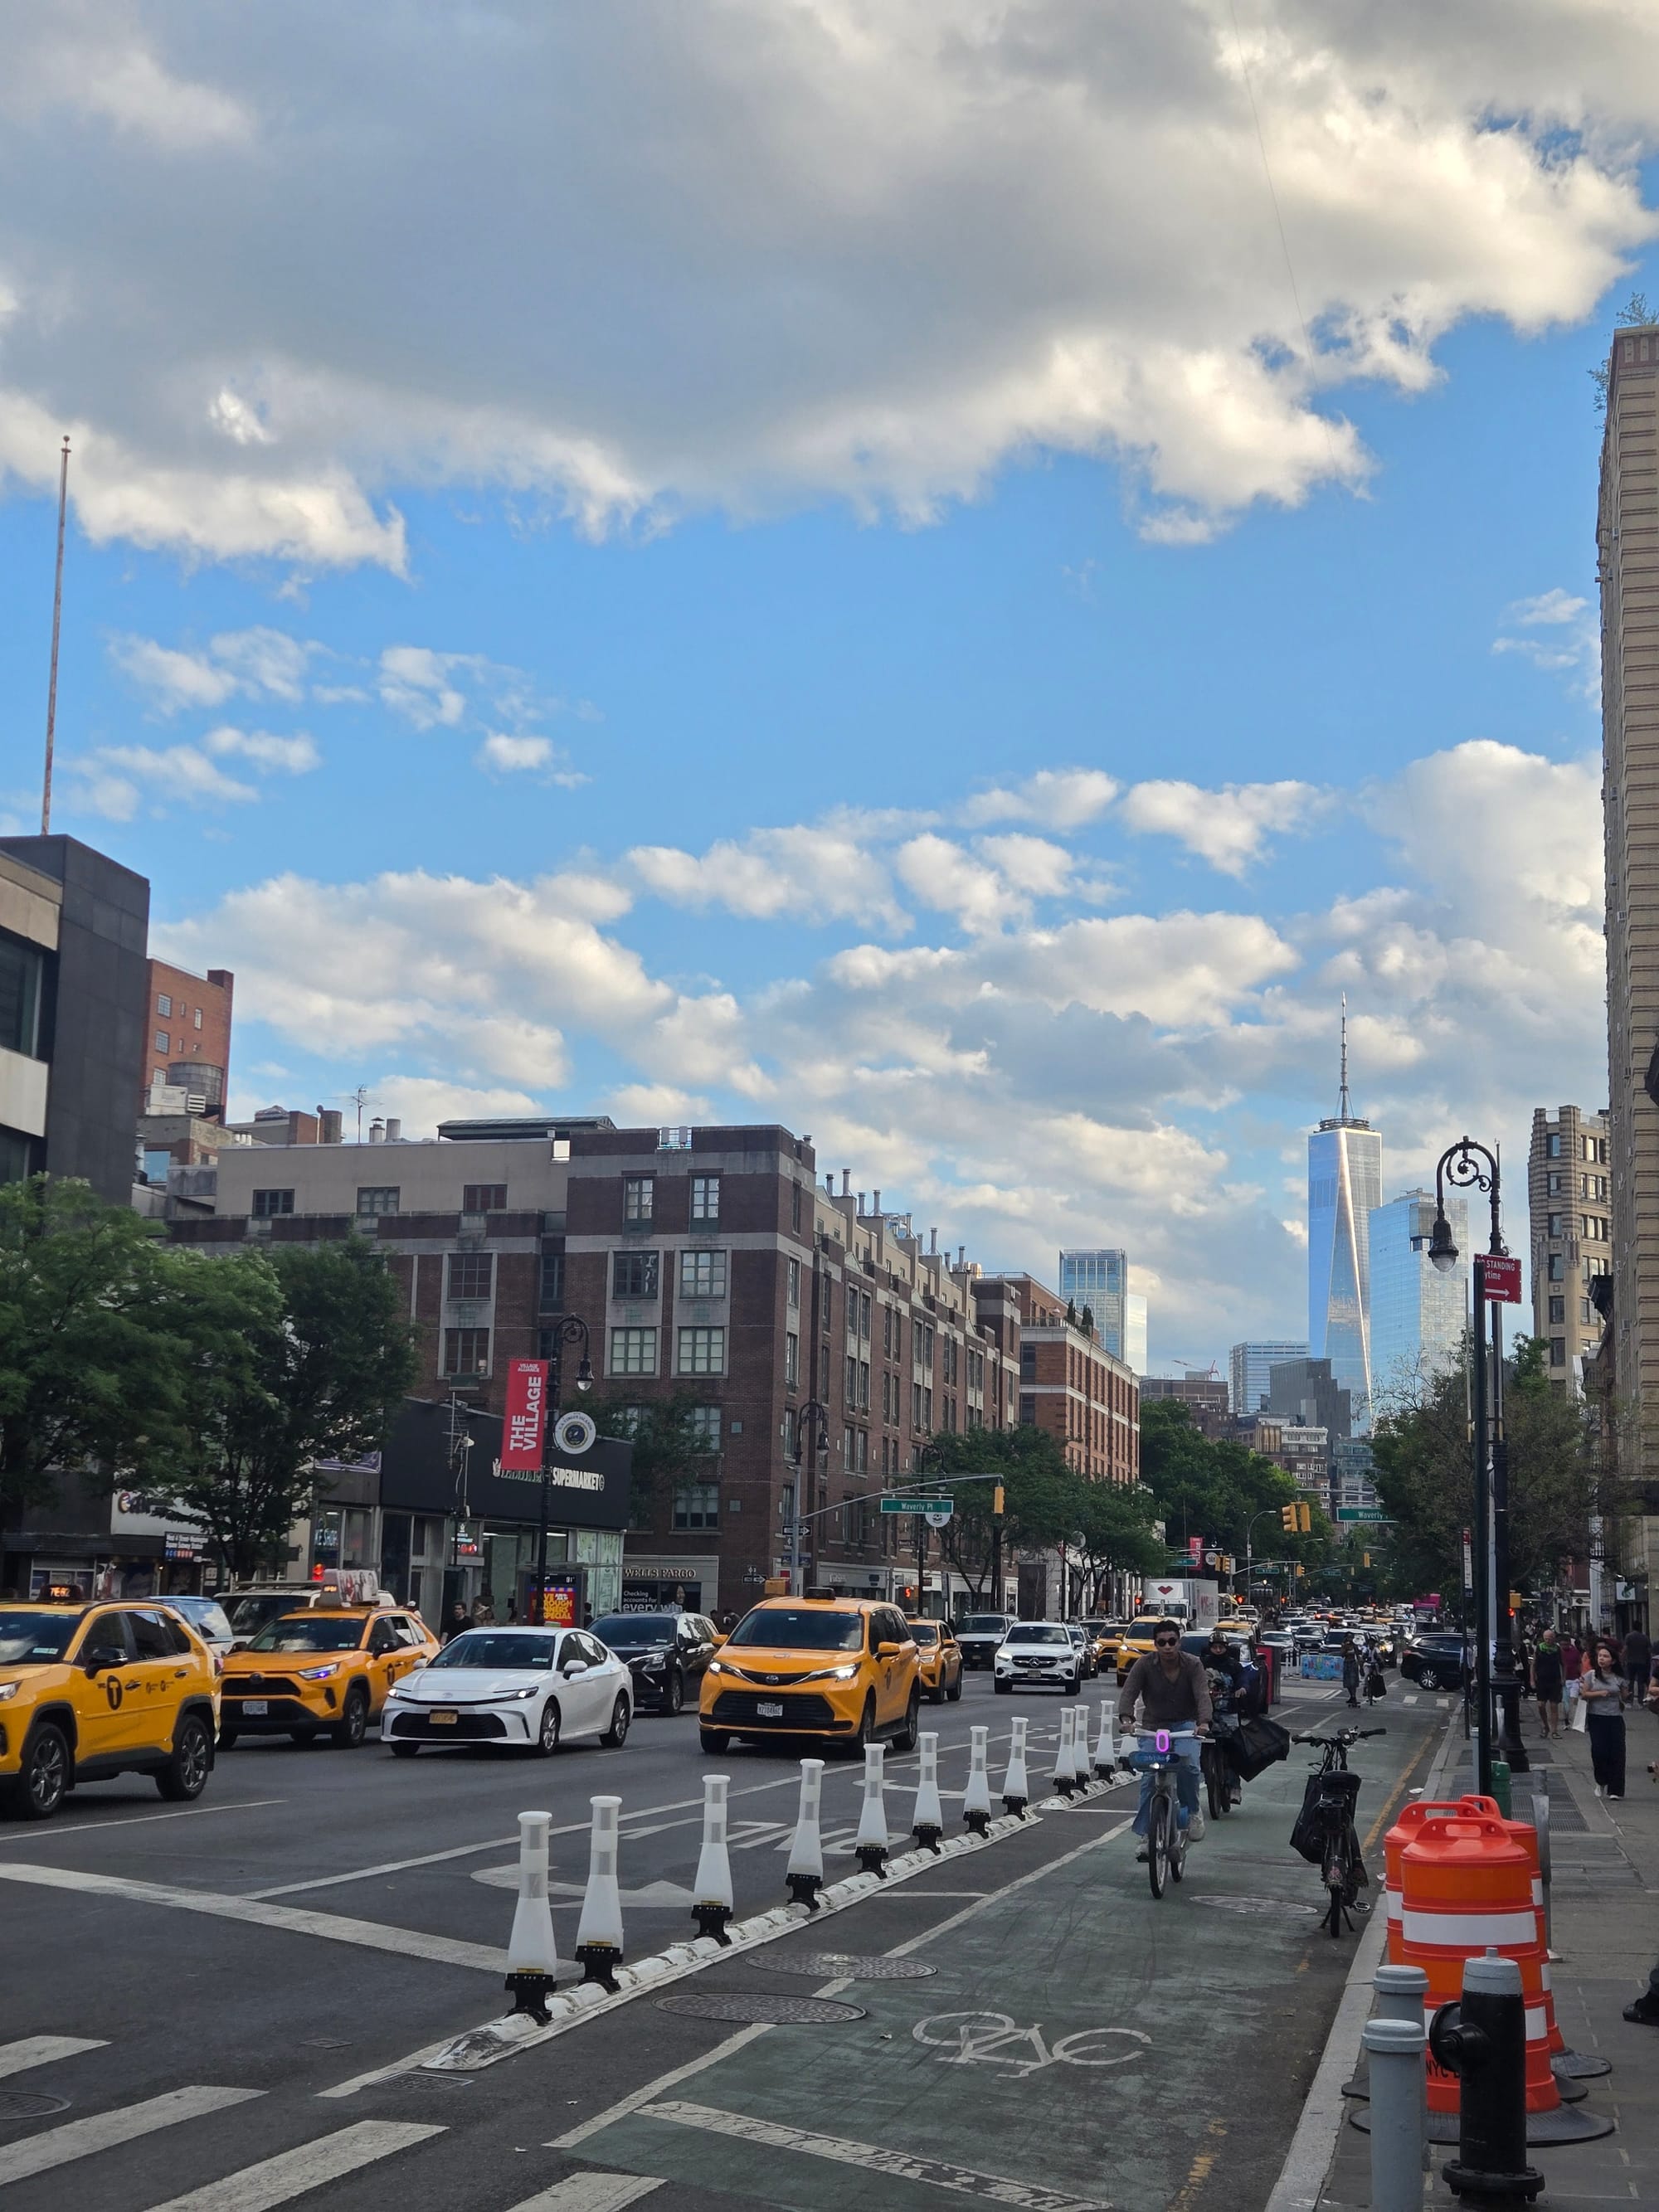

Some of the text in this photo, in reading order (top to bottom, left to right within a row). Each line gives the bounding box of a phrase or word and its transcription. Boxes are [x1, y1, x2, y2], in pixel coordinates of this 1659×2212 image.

[1486, 1260, 1515, 1271] STANDING
[1485, 1271, 1501, 1280] ytime
[523, 1377, 542, 1451] VILLAGE
[510, 1416, 526, 1451] THE
[552, 1466, 600, 1490] SUPERMARKET
[901, 1503, 925, 1511] Waverly
[1358, 1511, 1384, 1519] Waverly
[625, 1568, 696, 1578] WELLS FARGO
[623, 1603, 657, 1613] every
